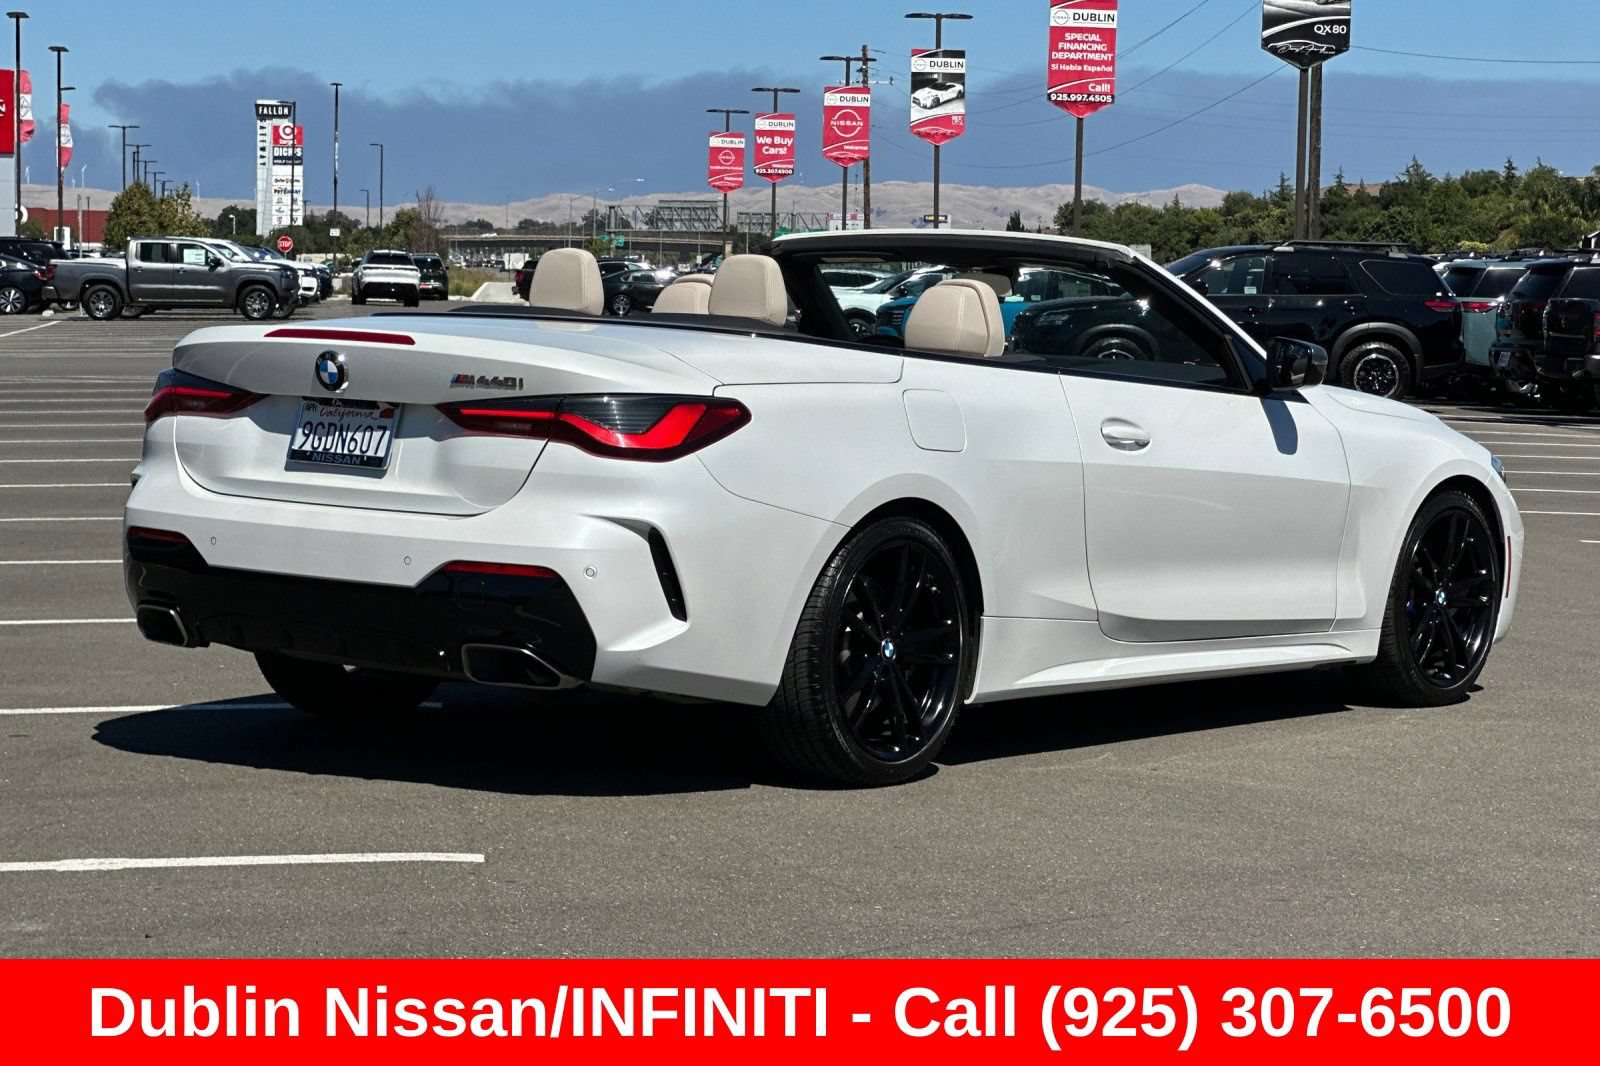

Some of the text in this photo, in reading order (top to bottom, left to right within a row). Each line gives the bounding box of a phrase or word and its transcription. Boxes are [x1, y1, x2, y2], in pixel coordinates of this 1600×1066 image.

[1072, 12, 1115, 22] DUBLIN
[1064, 32, 1102, 42] SPECIAL
[1058, 42, 1108, 51] FINANCING
[1051, 52, 1114, 61] DEPARTMENT
[929, 60, 964, 69] DUBLIN
[1083, 65, 1113, 73] Español
[1088, 83, 1111, 93] Call!
[839, 95, 869, 103] DUBLIN
[1050, 93, 1113, 103] 925.997.4505
[258, 106, 289, 115] FALLON
[756, 135, 794, 147] We Buy
[273, 147, 302, 157] DICK'S
[762, 145, 787, 155] Cars!
[279, 240, 291, 248] STOP
[319, 407, 378, 422] California
[298, 421, 388, 456] 9GDN607
[311, 452, 361, 465] NISSAN
